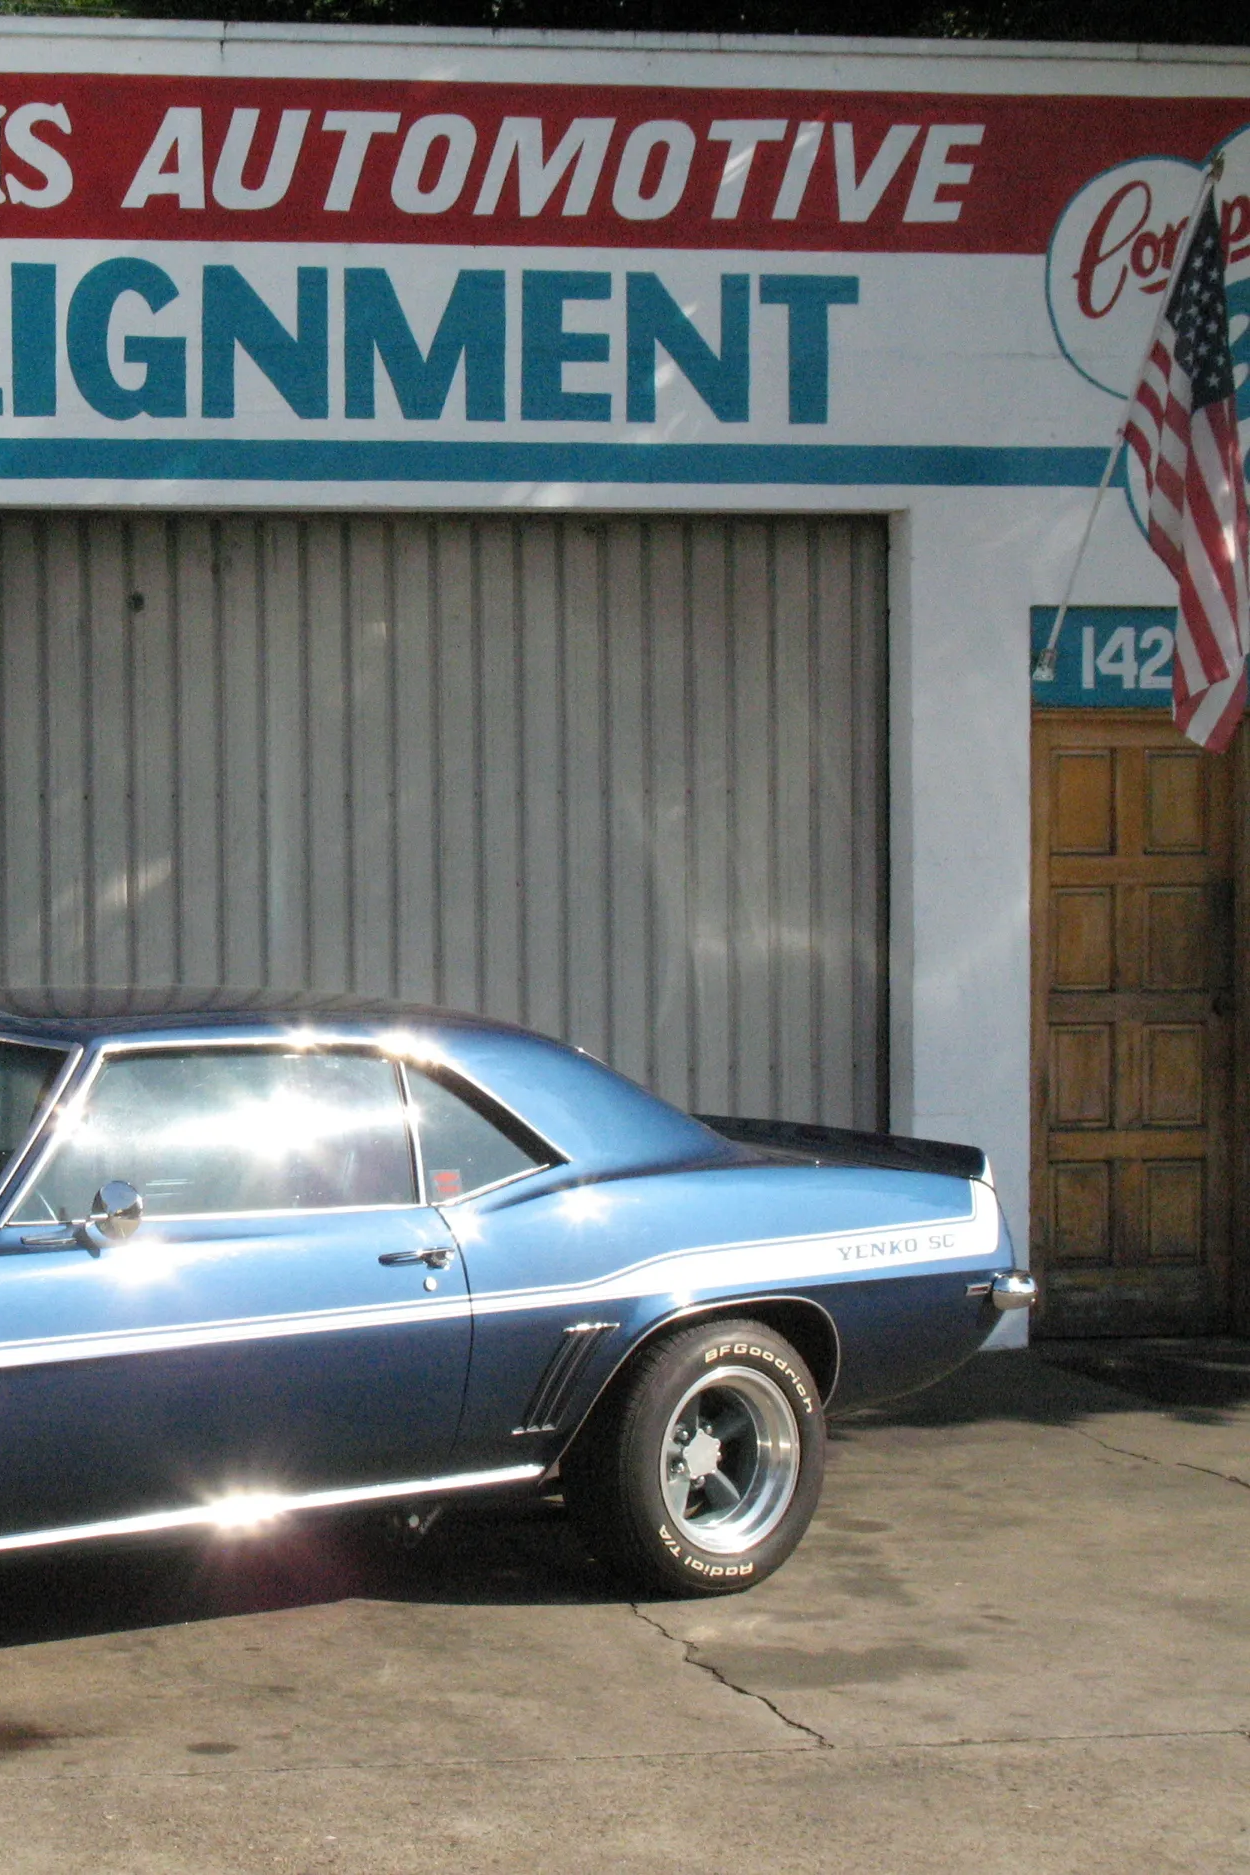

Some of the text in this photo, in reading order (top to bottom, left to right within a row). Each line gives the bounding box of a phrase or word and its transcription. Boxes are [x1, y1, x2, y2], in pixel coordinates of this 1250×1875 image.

[120, 106, 986, 224] AUTOMOTIVE
[1081, 625, 1175, 690] 142
[837, 1233, 956, 1261] YENKO SC
[703, 1343, 814, 1414] BFGoodrich
[657, 1523, 755, 1578] Radial T/A
